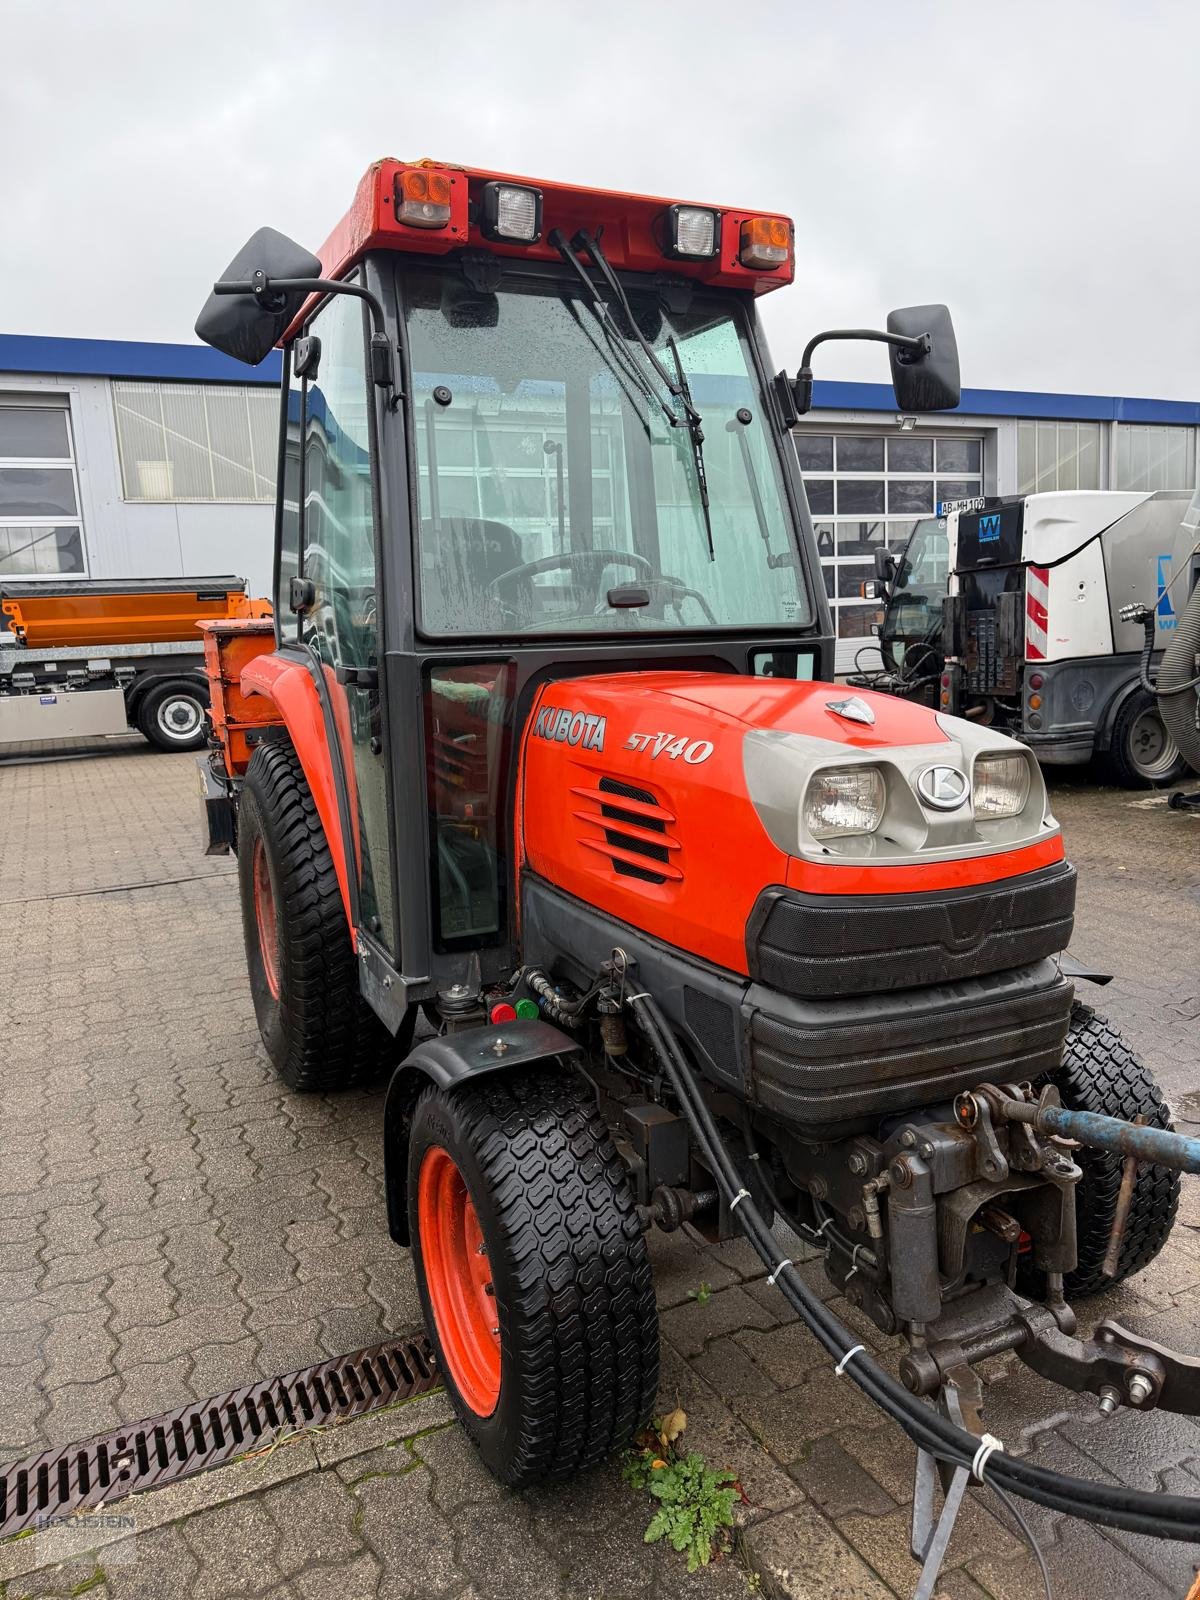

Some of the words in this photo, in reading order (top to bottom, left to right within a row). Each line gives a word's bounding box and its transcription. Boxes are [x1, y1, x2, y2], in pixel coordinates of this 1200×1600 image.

[943, 503, 953, 515] AB
[957, 500, 968, 511] MH
[533, 705, 607, 752] KUBOTA
[624, 732, 714, 764] STV40
